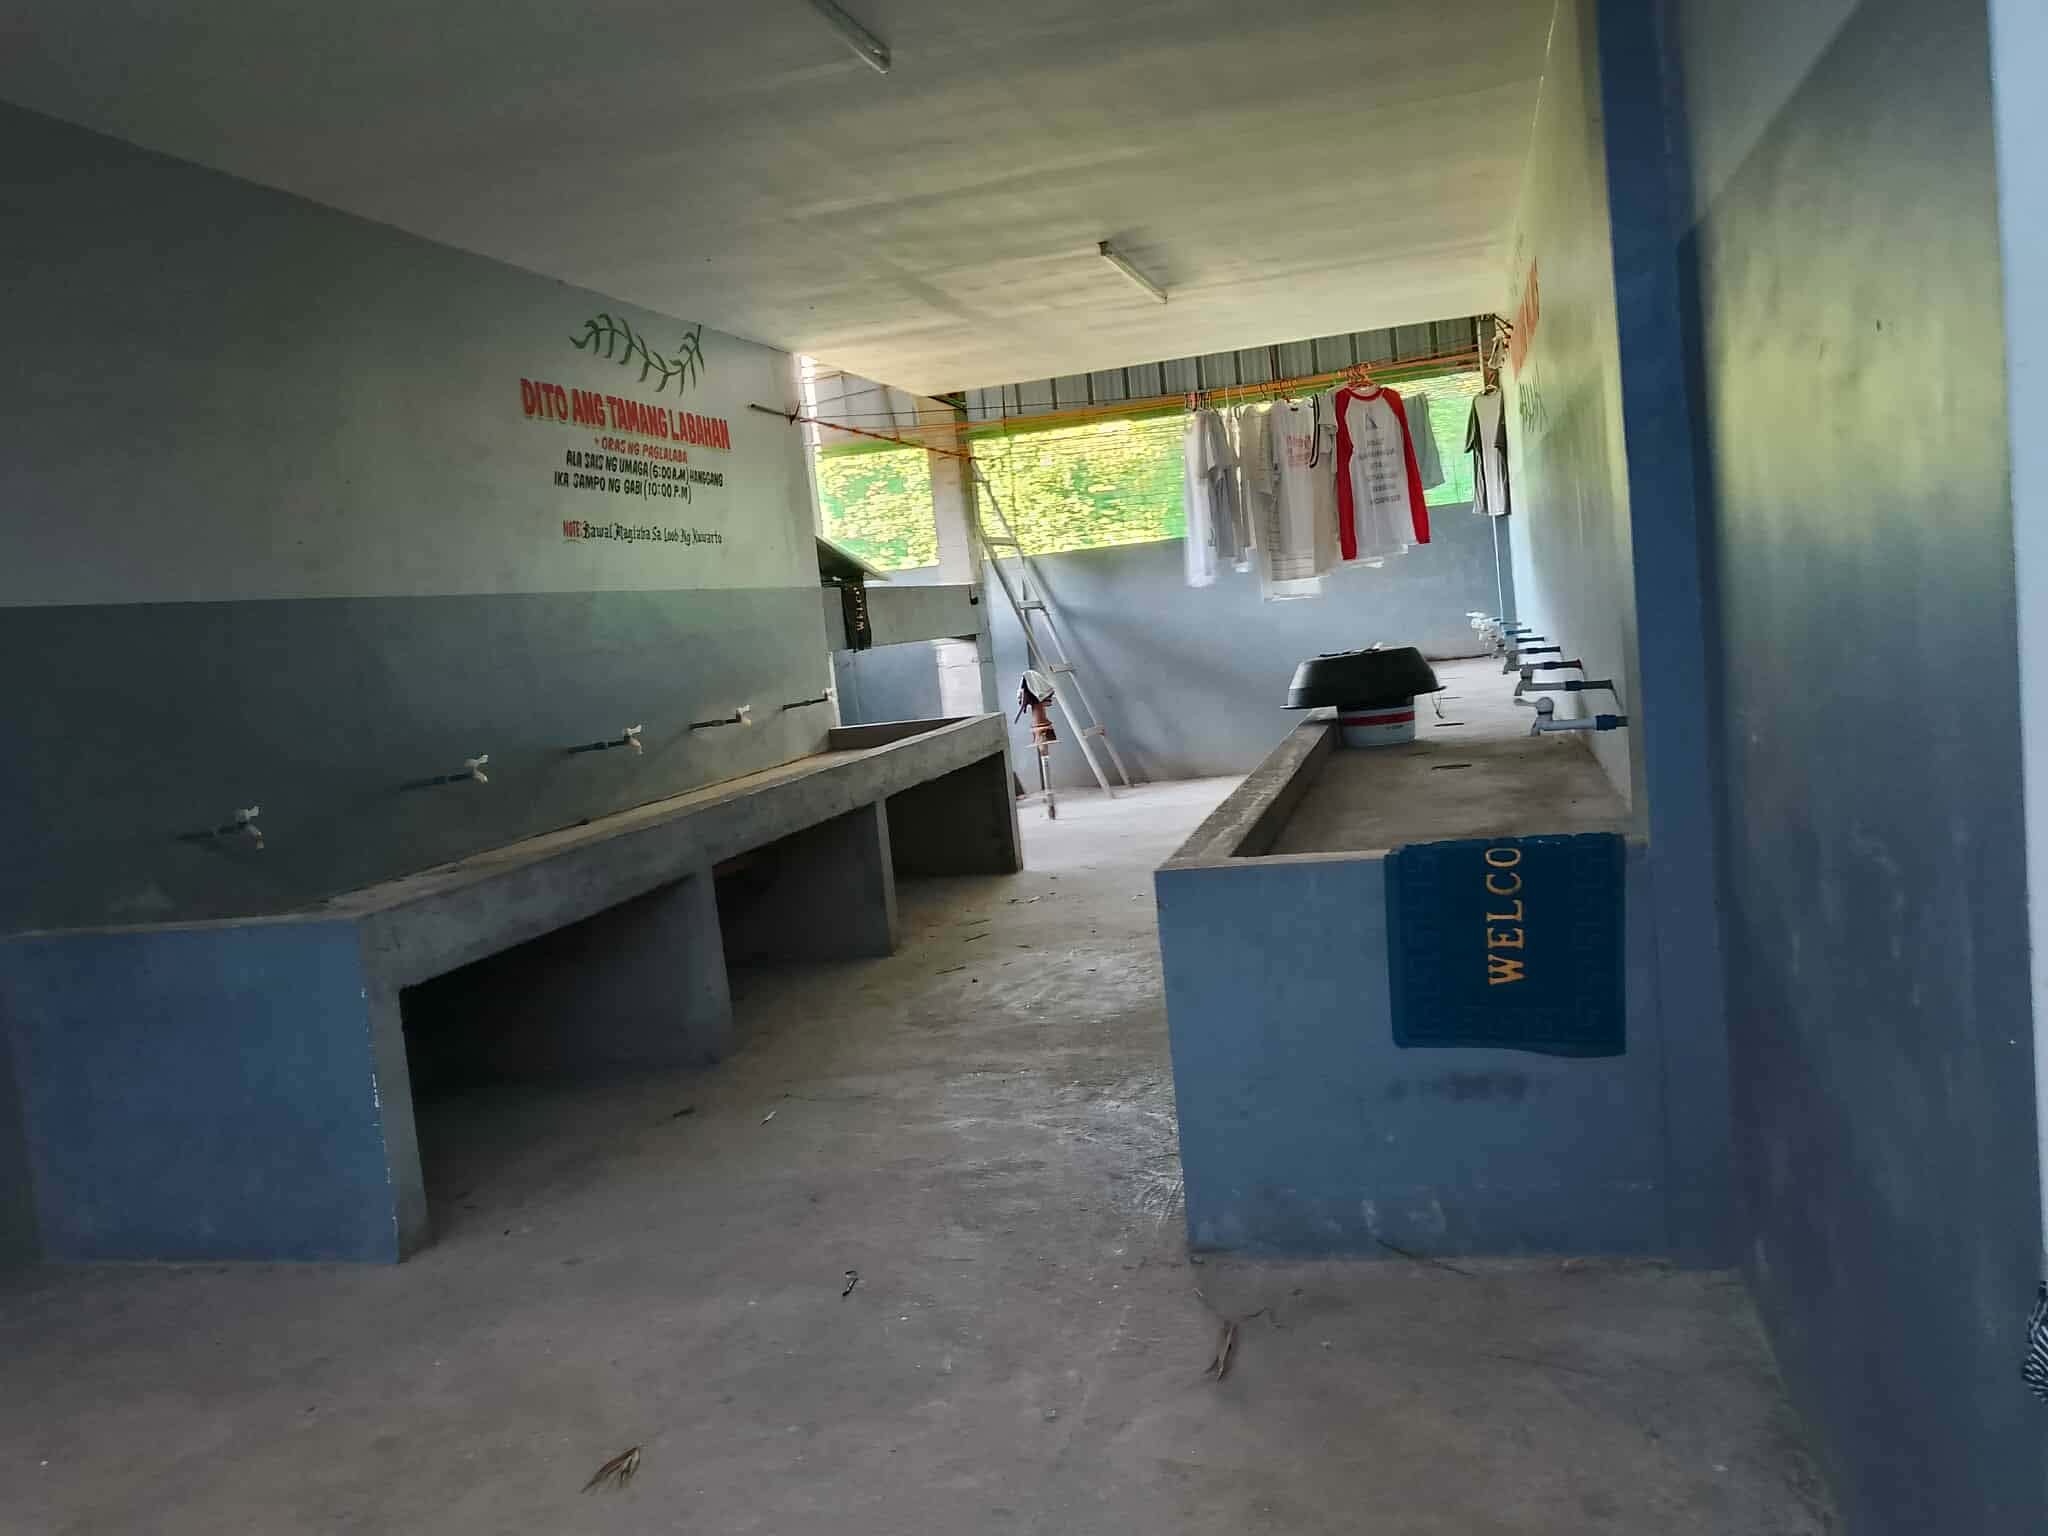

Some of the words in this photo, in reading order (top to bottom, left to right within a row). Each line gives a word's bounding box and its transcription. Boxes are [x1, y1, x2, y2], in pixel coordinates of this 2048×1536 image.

[520, 378, 569, 422] DITO
[571, 388, 605, 427] ANG
[606, 396, 668, 439] TAMANG
[669, 409, 731, 450] LABAHAN
[566, 450, 583, 469] ALA
[585, 452, 604, 471] SAIS
[606, 456, 618, 473] NG
[601, 437, 626, 454] ORAS
[627, 442, 640, 457] NG
[642, 444, 688, 464] PAGLALABA
[554, 471, 569, 488] IKA
[573, 473, 605, 492] SAMPO
[608, 478, 620, 493] NG
[1485, 847, 1525, 984] WELCO
